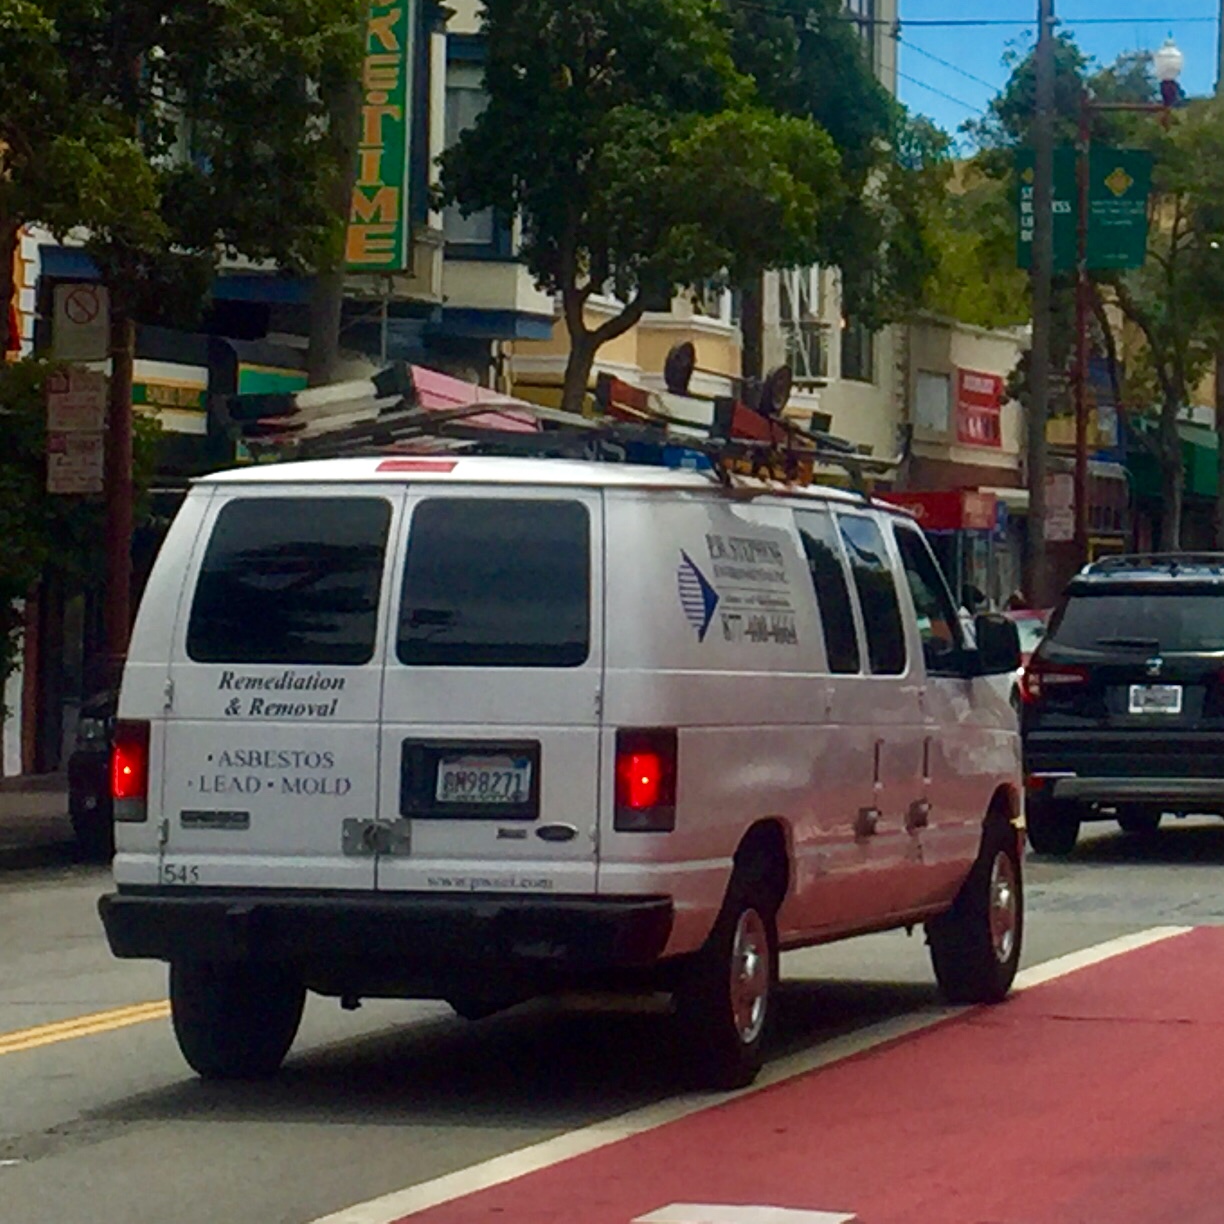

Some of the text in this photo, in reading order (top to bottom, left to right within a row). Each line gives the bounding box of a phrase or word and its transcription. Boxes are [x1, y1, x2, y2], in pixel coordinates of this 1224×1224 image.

[218, 670, 345, 691] Remediation
[224, 697, 339, 717] & Removal
[218, 749, 335, 769] ASBESTOS
[199, 775, 351, 796] LEAD MOLD
